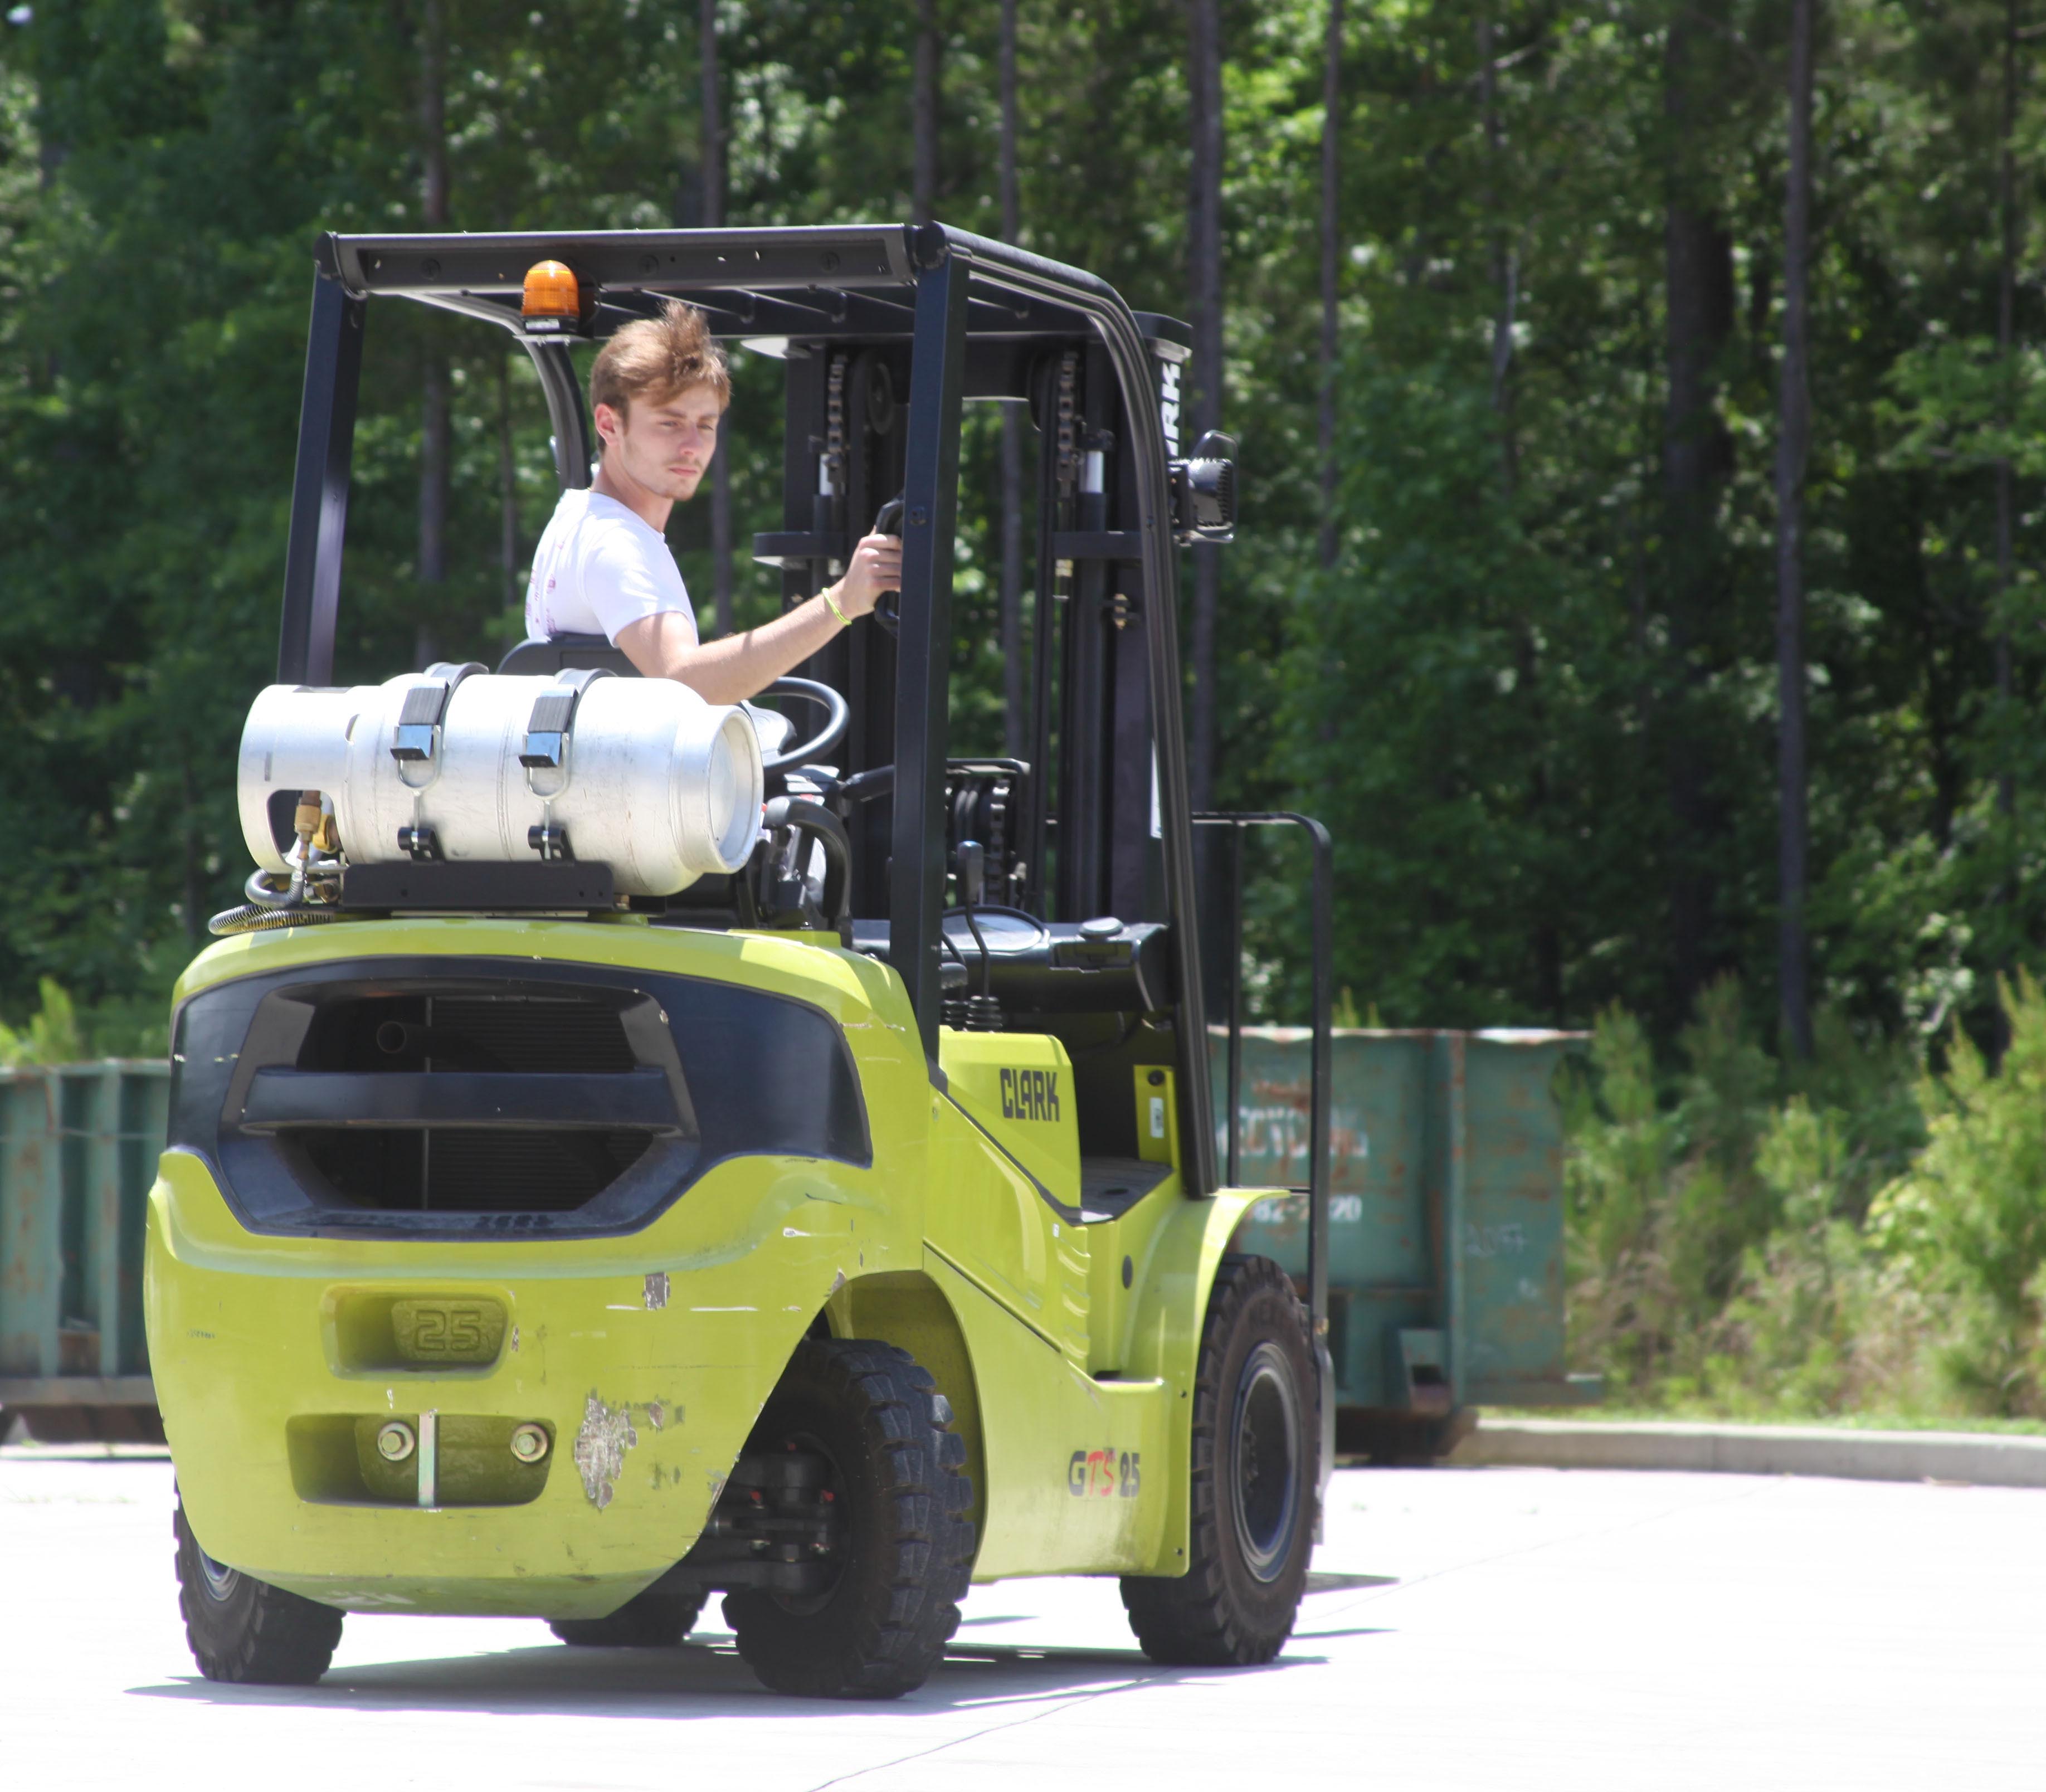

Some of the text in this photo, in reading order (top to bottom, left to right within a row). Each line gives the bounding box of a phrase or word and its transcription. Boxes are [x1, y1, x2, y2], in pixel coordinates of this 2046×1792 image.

[1000, 1068, 1060, 1122] CLARK
[416, 1309, 481, 1352] 25
[1119, 1452, 1141, 1498] 25
